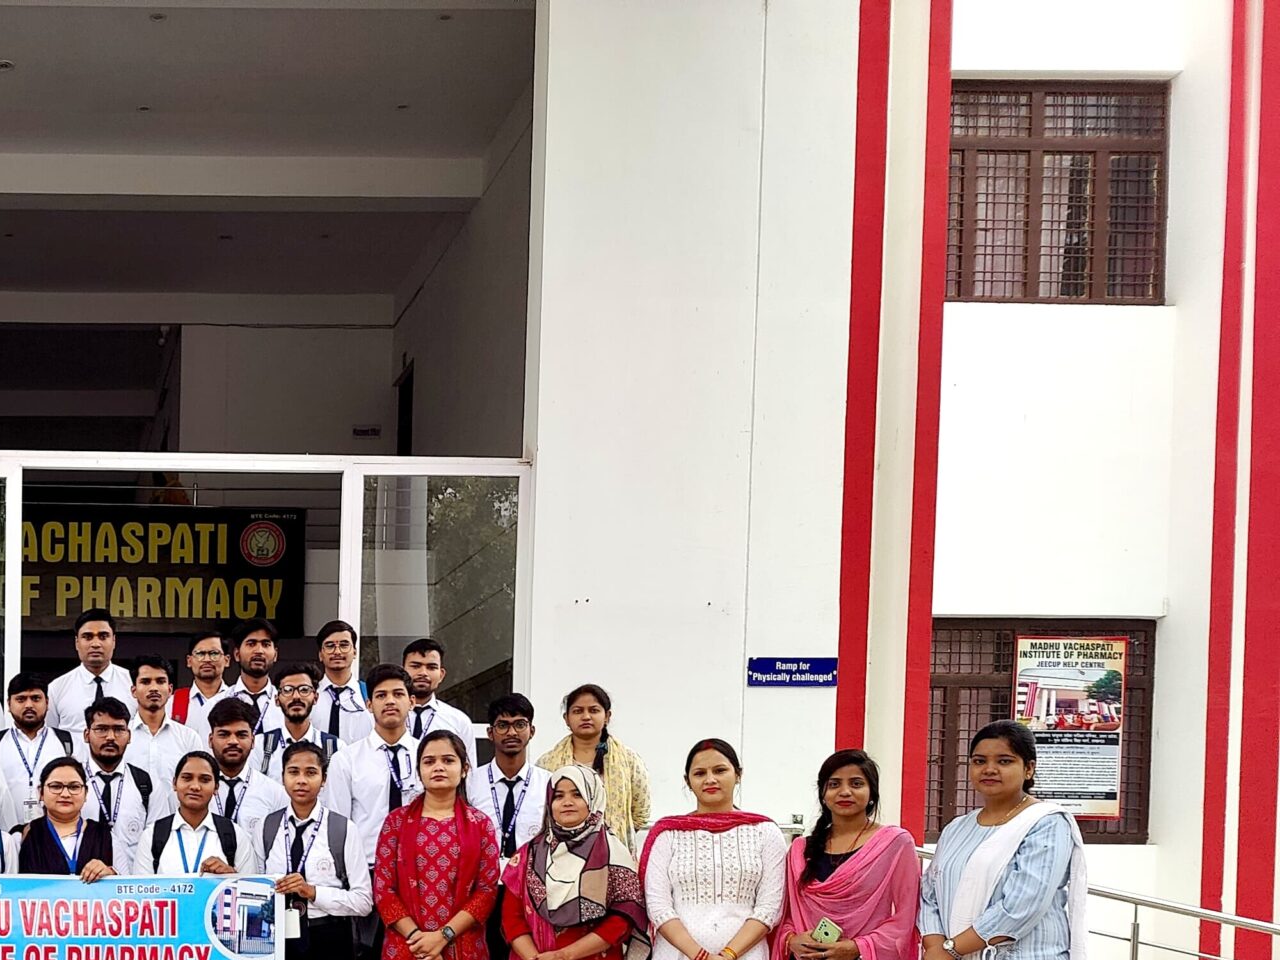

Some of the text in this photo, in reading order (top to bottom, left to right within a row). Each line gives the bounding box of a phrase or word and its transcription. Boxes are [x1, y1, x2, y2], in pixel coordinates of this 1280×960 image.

[18, 521, 228, 564] ACHASPATI
[55, 576, 283, 619] PHARMACY
[1030, 642, 1061, 651] MADHU
[1063, 642, 1114, 652] VACHASPATI
[1019, 650, 1124, 660] INSTITUTE OF PHARMACY
[775, 661, 810, 671] Ramp for
[1036, 660, 1061, 668] JEECUP
[1080, 661, 1105, 669] CENTRE
[752, 672, 832, 682] Physically challenged
[116, 885, 134, 894] BTE
[137, 884, 160, 894] Code
[170, 884, 194, 894] 4172
[21, 900, 176, 937] VACHASPATI
